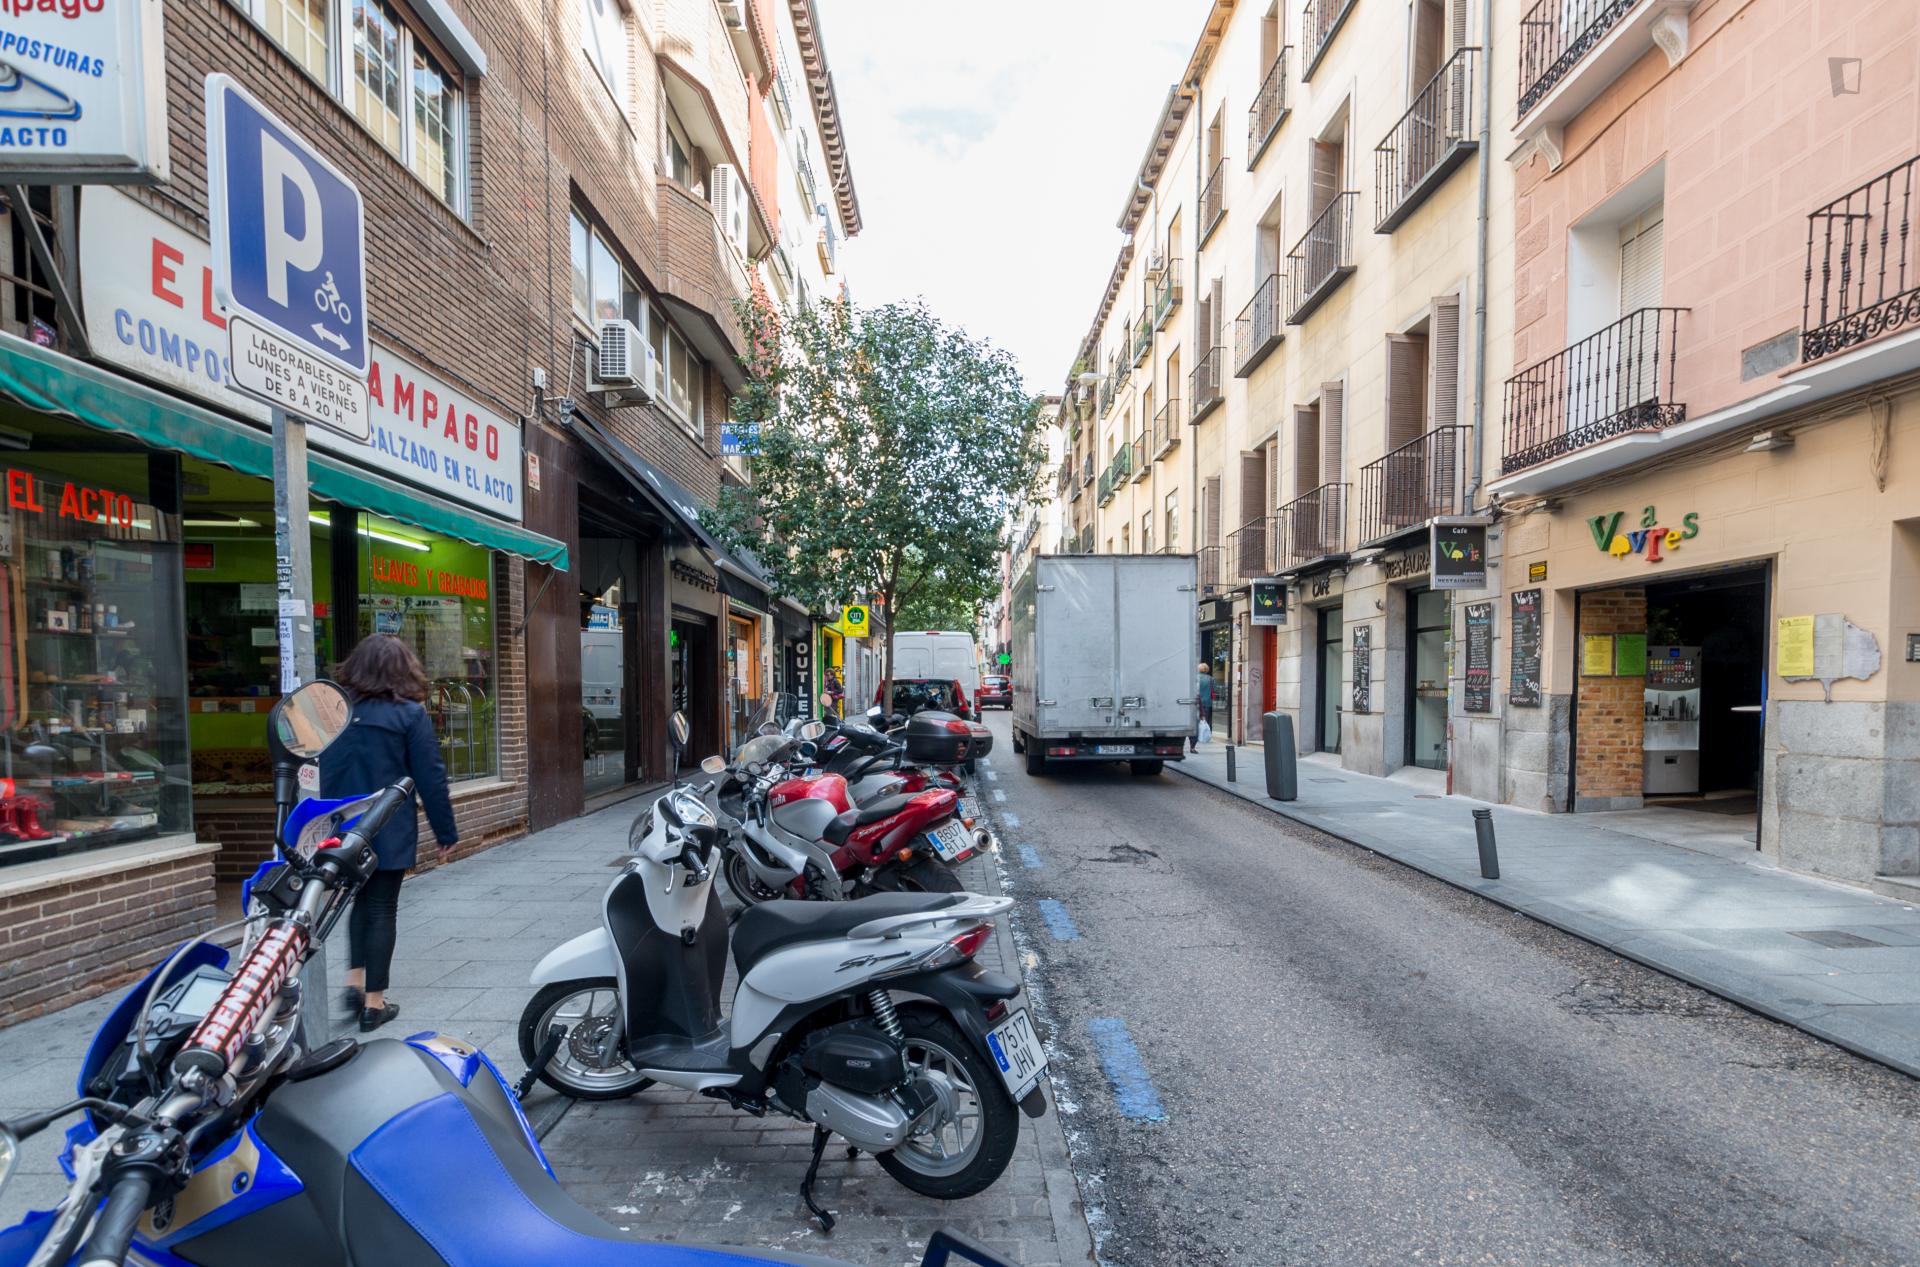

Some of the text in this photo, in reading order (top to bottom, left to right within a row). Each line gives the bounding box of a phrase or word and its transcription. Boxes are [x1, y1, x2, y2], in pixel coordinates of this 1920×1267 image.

[0, 30, 104, 77] POSTURAS
[0, 127, 67, 147] ACTO
[261, 127, 324, 309] P
[247, 350, 358, 415] LUNES A VIERNES
[252, 333, 353, 397] LABORABLES DE
[265, 376, 283, 396] DE
[288, 388, 297, 402] 8
[302, 393, 311, 410] A
[315, 400, 331, 418] 20
[7, 468, 133, 529] EL ACTO
[444, 455, 460, 483] EN
[465, 465, 481, 491] EL
[485, 474, 513, 505] ACTO
[373, 554, 489, 601] LLAVES Y GRABADOS
[936, 822, 962, 842] 8607
[945, 838, 967, 855] BTJ
[197, 921, 296, 1050] RENTHAL
[997, 1015, 1029, 1056] 7517
[1013, 1043, 1036, 1079] JHV
